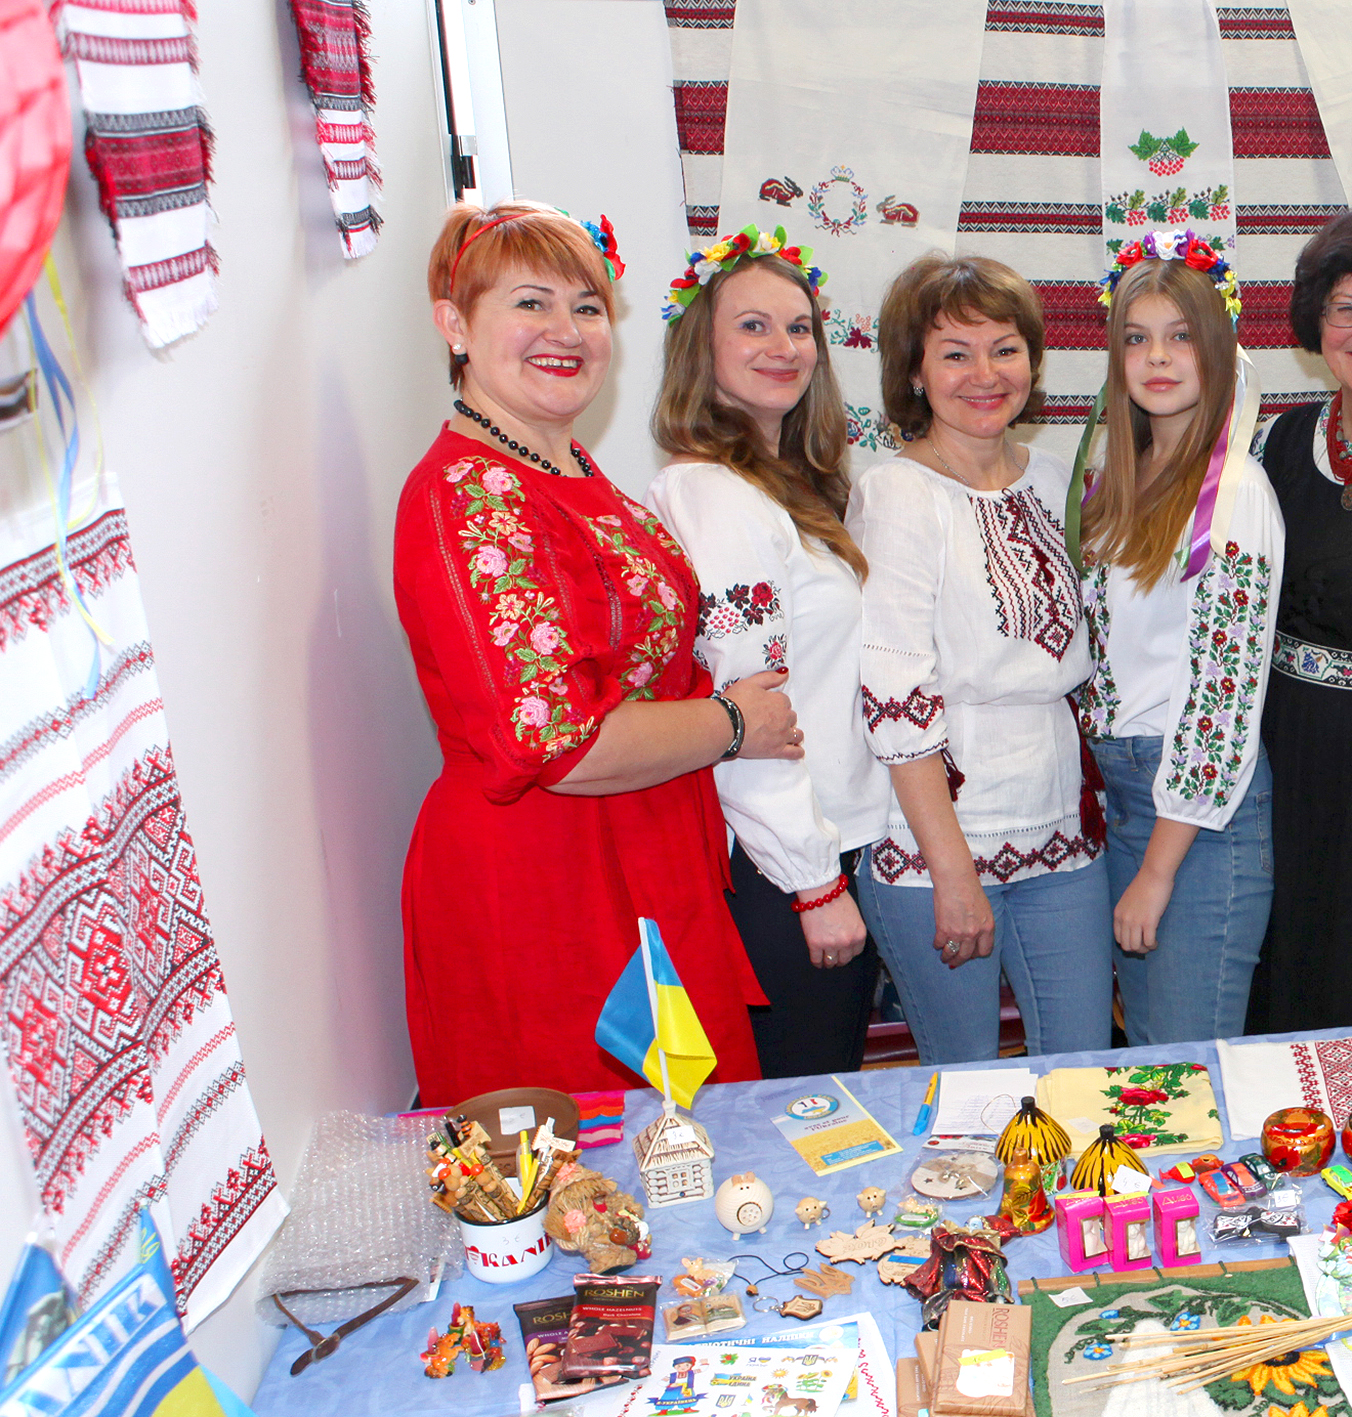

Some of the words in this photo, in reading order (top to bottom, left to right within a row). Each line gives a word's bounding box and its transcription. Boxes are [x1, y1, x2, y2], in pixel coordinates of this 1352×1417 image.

[584, 1288, 645, 1299] ROSHEN
[532, 1310, 572, 1324] ROSH
[993, 1307, 1010, 1348] ROSHEN
[537, 1331, 563, 1339] WHOLE
